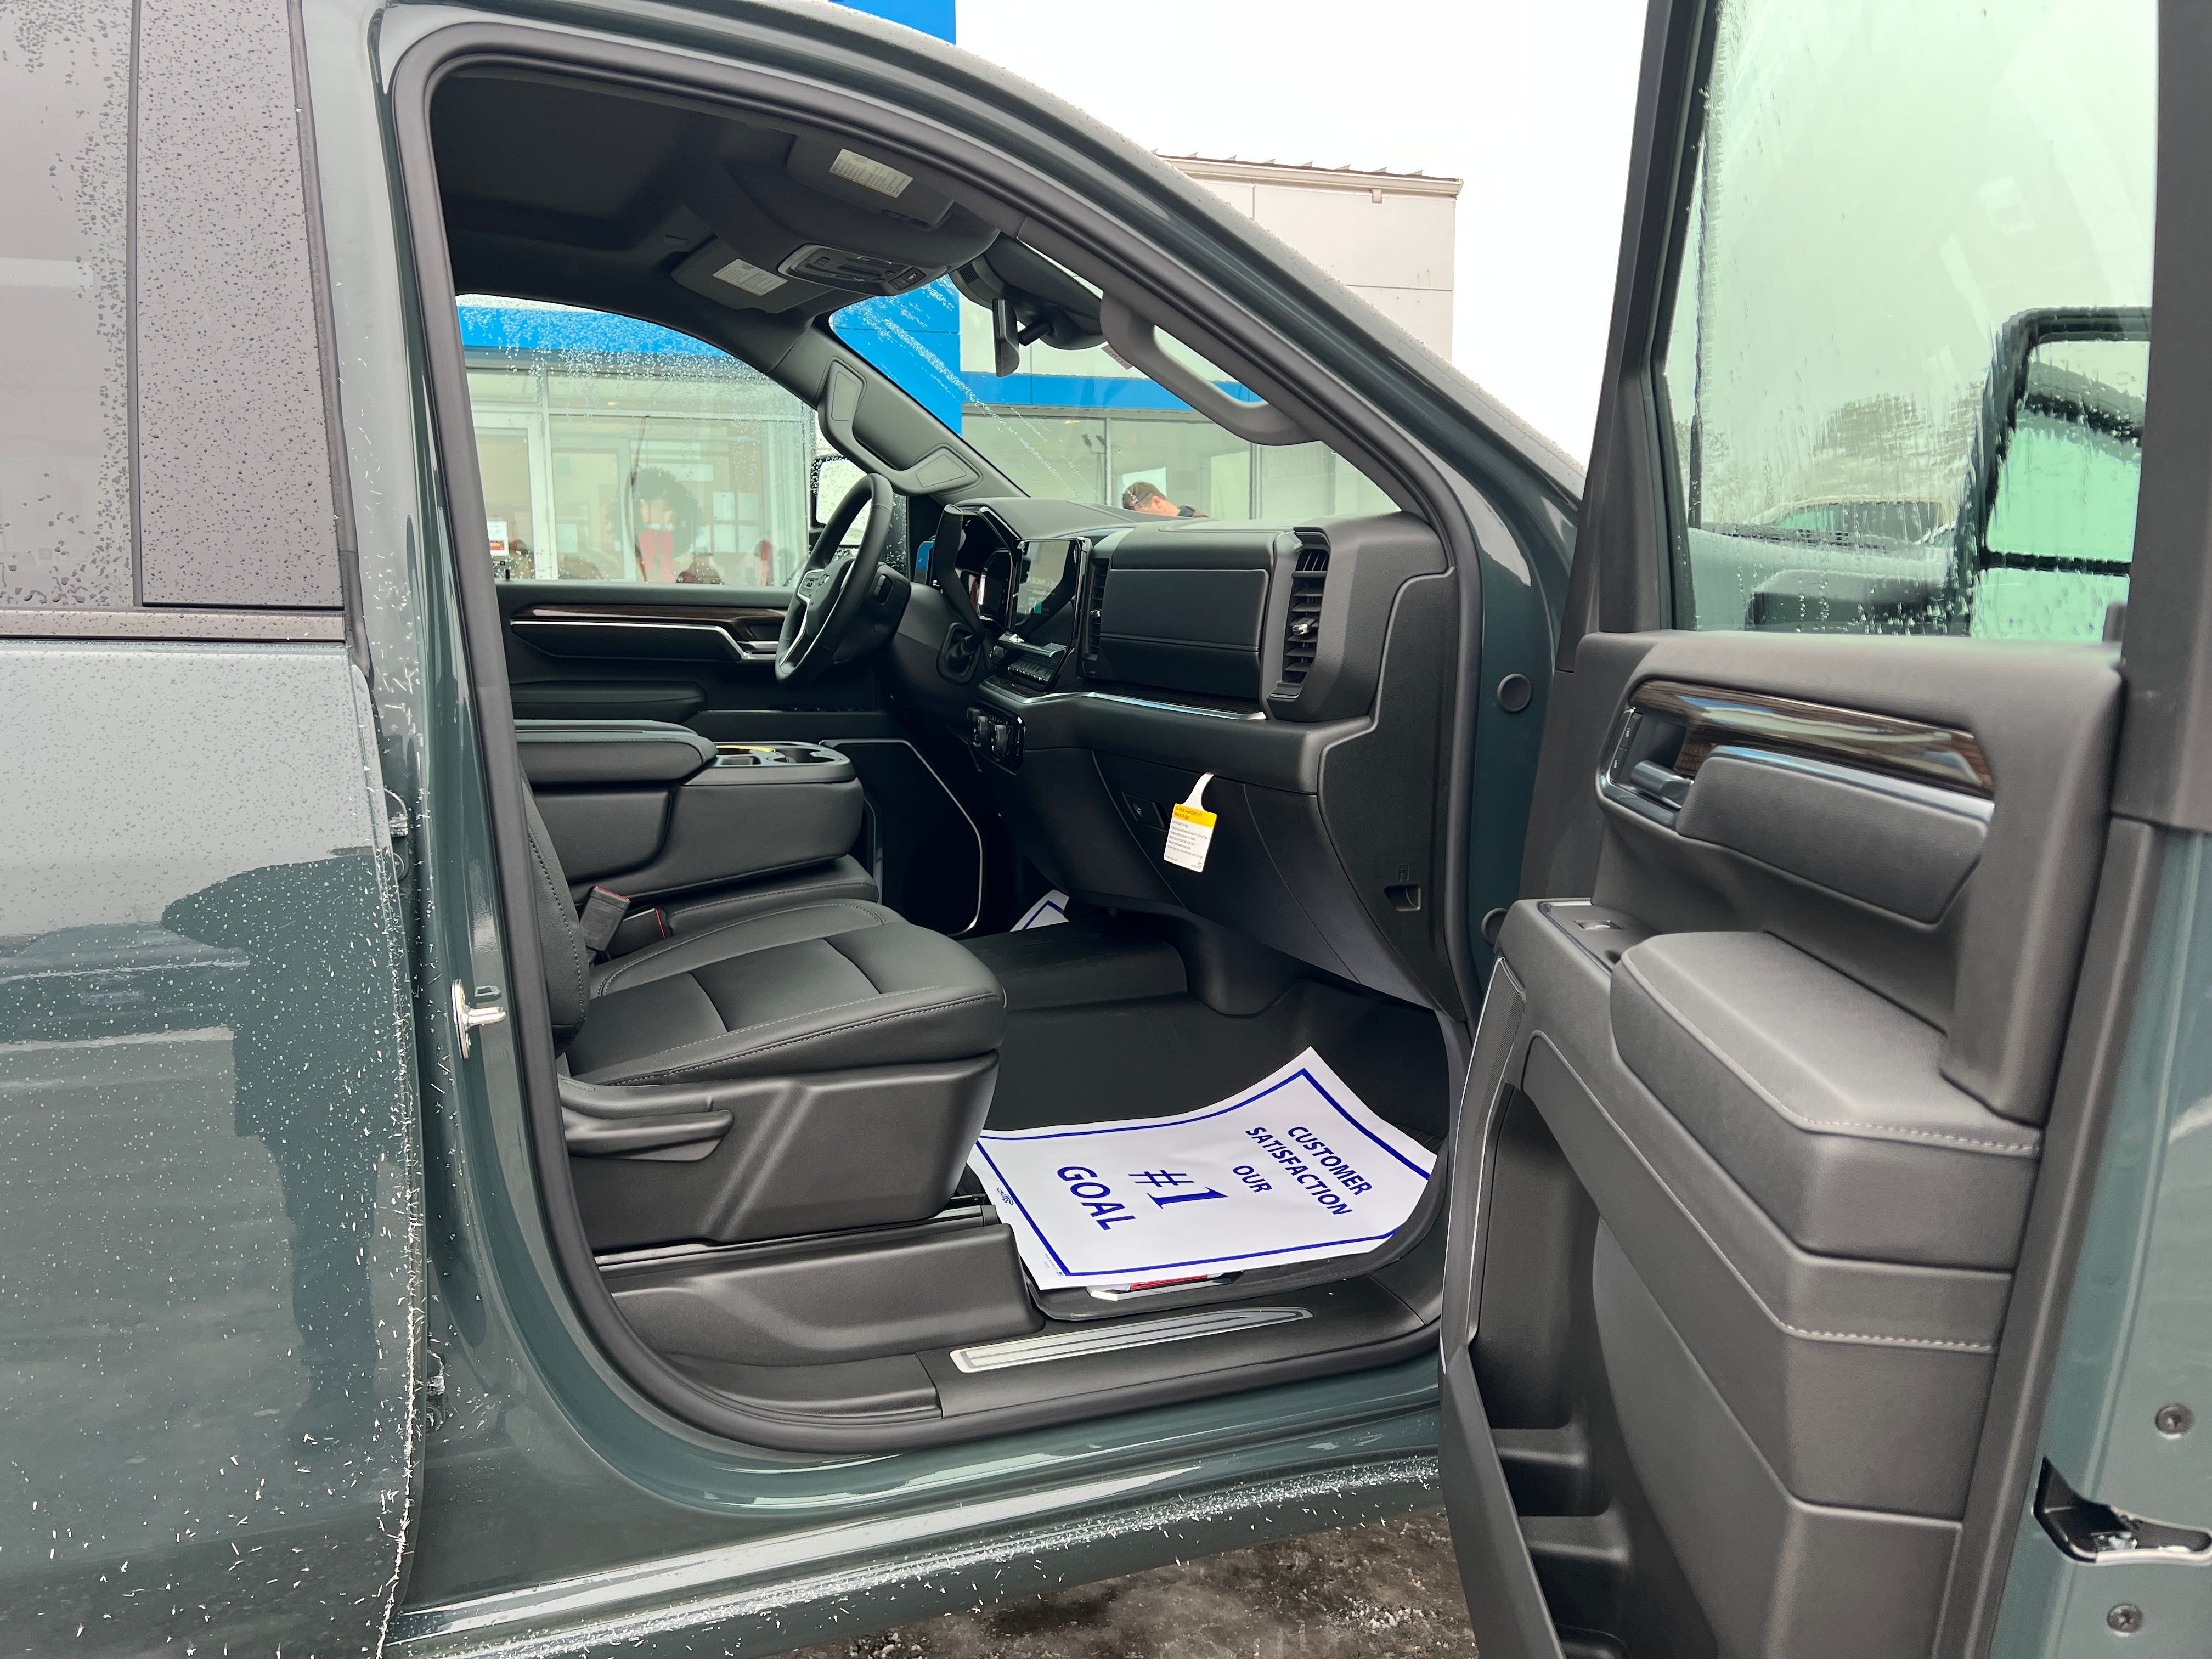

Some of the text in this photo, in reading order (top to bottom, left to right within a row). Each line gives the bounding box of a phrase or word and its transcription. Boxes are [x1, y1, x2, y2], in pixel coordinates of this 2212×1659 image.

[1128, 1170, 1228, 1209] #1
[1233, 1165, 1273, 1193] OUR
[1246, 1127, 1353, 1215] SATISFACTION
[1288, 1127, 1373, 1196] CUSTOMER
[1057, 1166, 1136, 1231] GOAL
